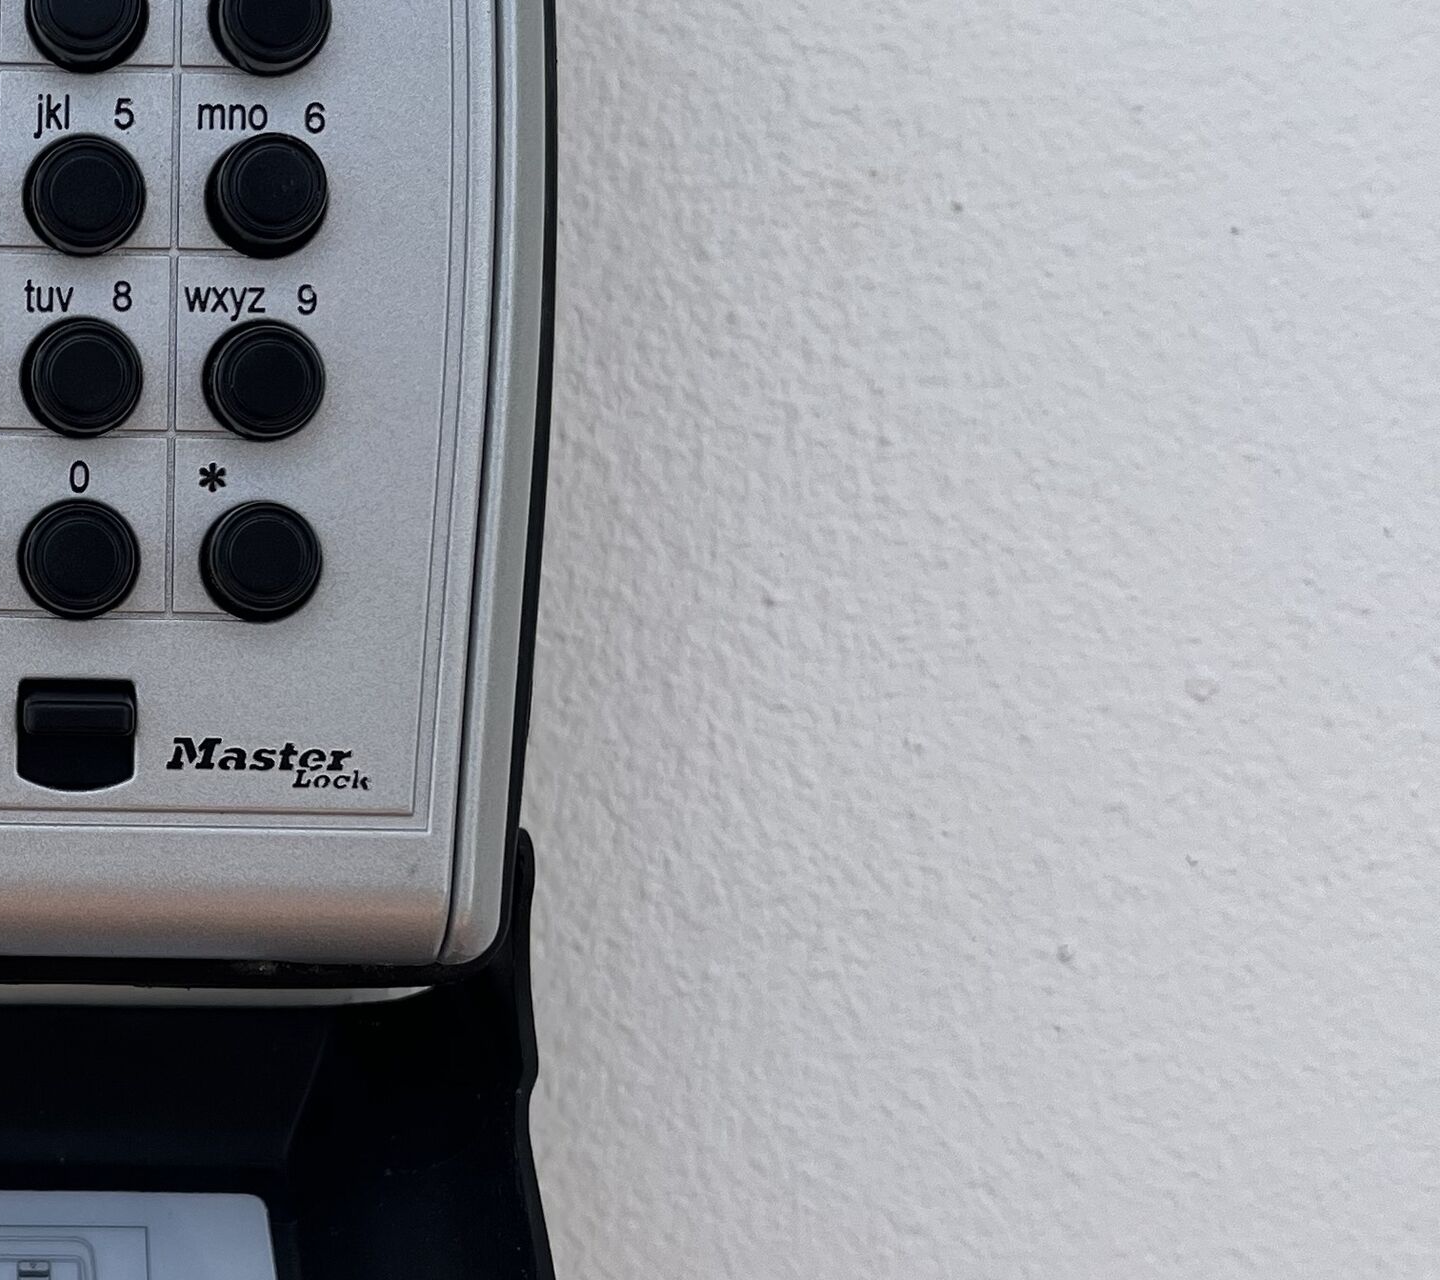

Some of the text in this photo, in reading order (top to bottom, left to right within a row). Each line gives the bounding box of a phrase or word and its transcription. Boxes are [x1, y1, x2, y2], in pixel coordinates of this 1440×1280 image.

[33, 93, 136, 138] jkl 5
[197, 101, 326, 135] mno 6
[24, 279, 133, 313] tuv 8
[184, 283, 318, 321] wxyz 9
[69, 460, 90, 494] 0
[165, 735, 355, 773] Master
[291, 767, 370, 792] Lock
